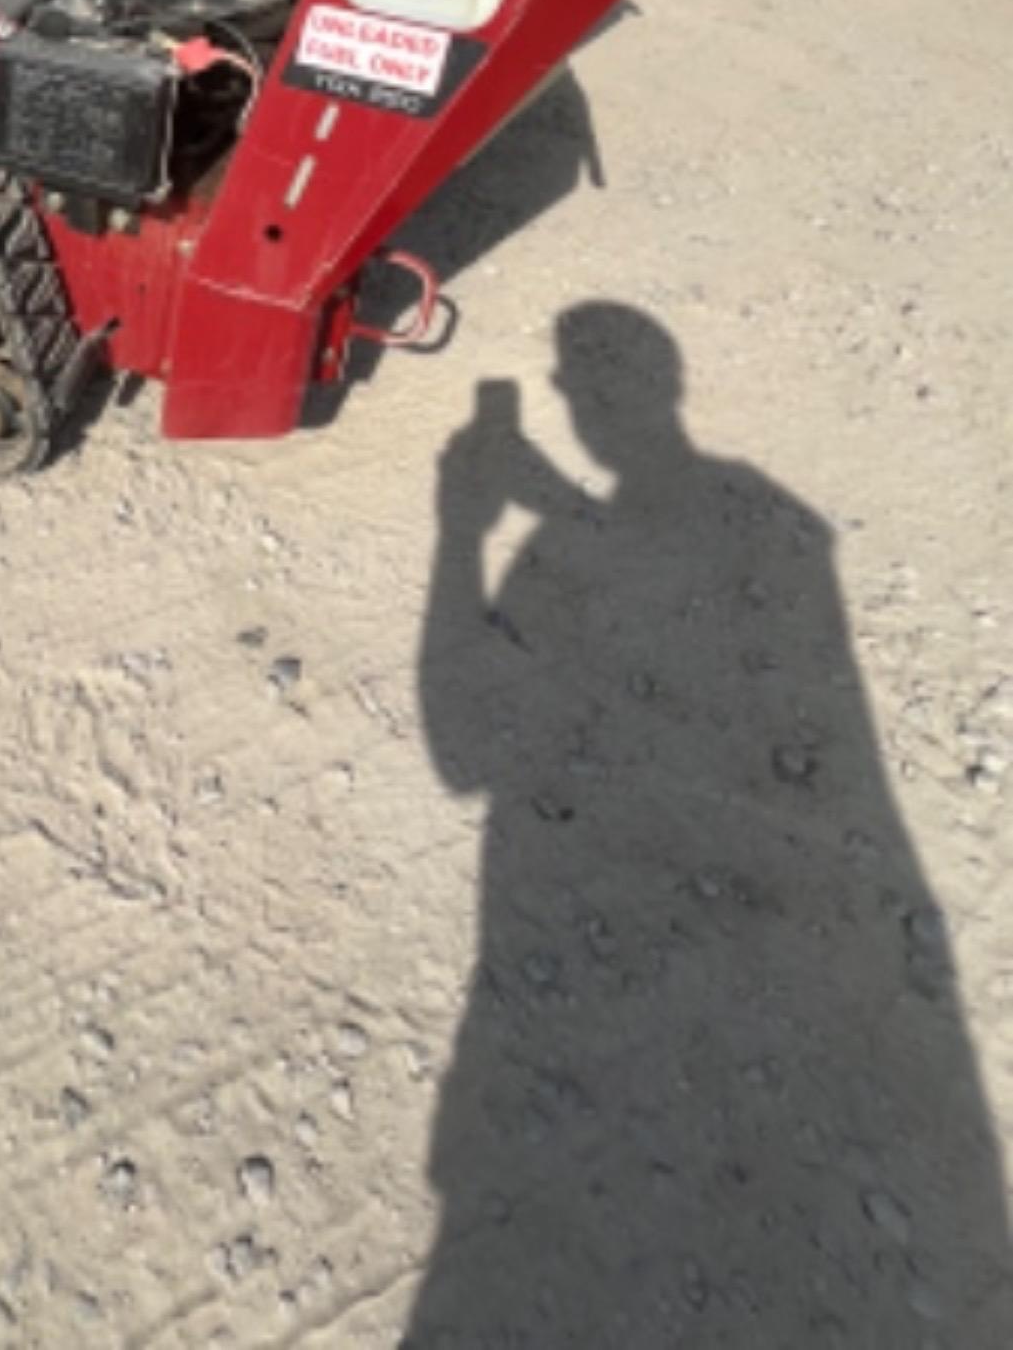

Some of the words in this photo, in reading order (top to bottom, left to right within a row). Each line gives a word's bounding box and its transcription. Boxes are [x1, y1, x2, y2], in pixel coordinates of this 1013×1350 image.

[311, 13, 439, 58] UNLEADED
[306, 38, 361, 69] FUEL
[370, 53, 431, 84] ONLY
